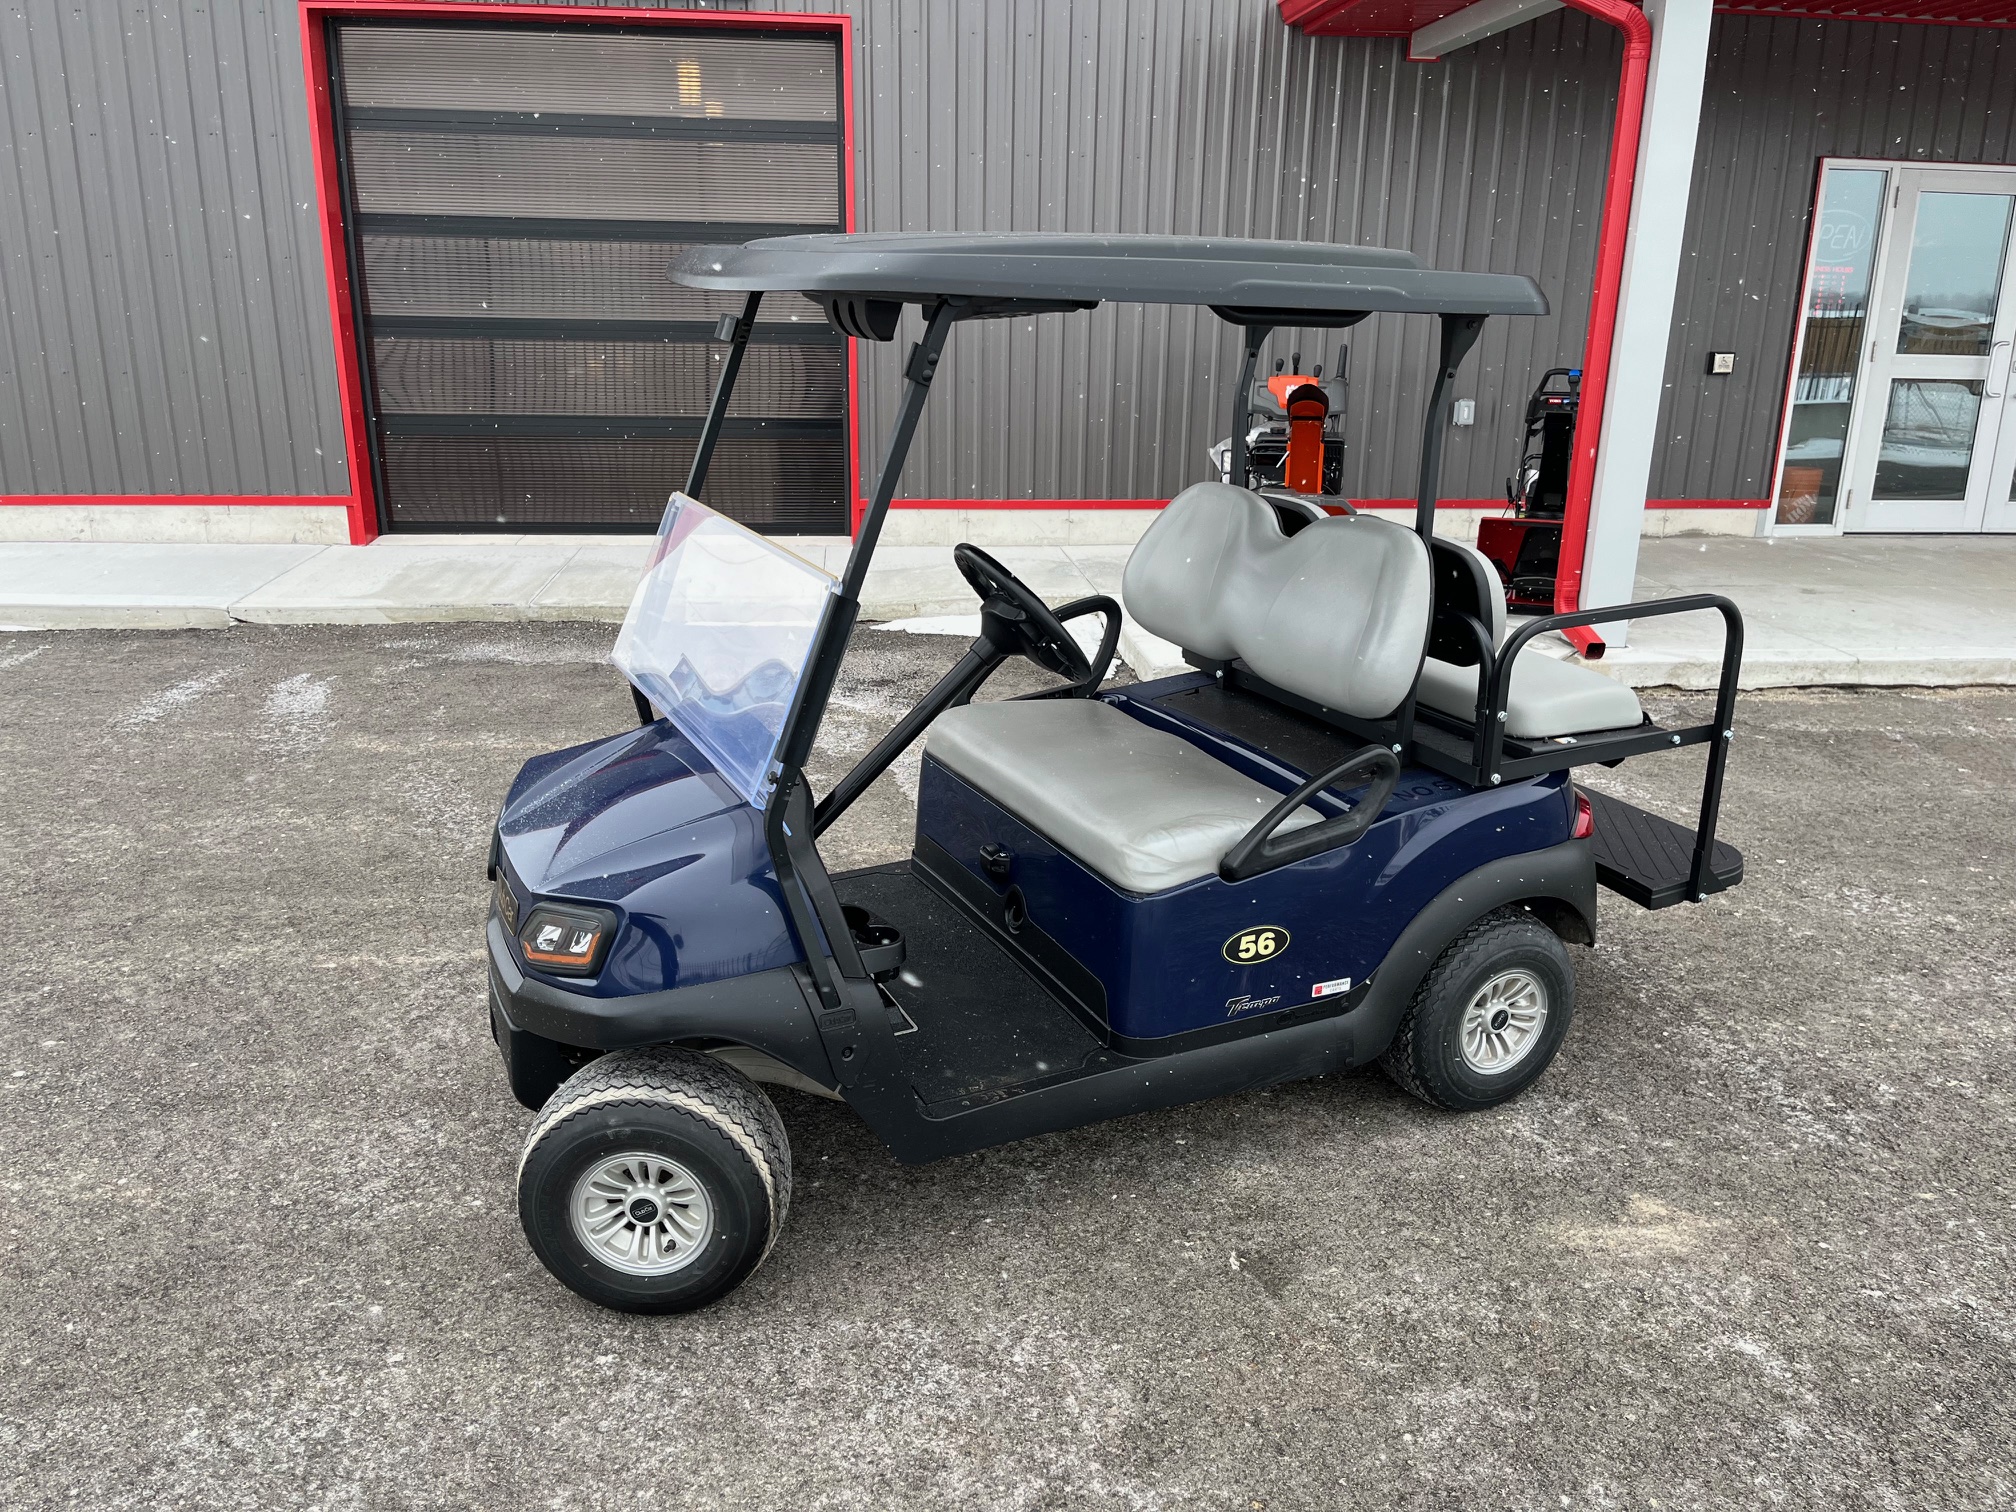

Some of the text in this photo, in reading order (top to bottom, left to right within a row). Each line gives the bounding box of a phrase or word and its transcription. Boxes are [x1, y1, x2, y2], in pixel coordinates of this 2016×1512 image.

[1819, 223, 1867, 249] PEN
[1237, 931, 1276, 959] 56
[1225, 994, 1281, 1017] Tempo
